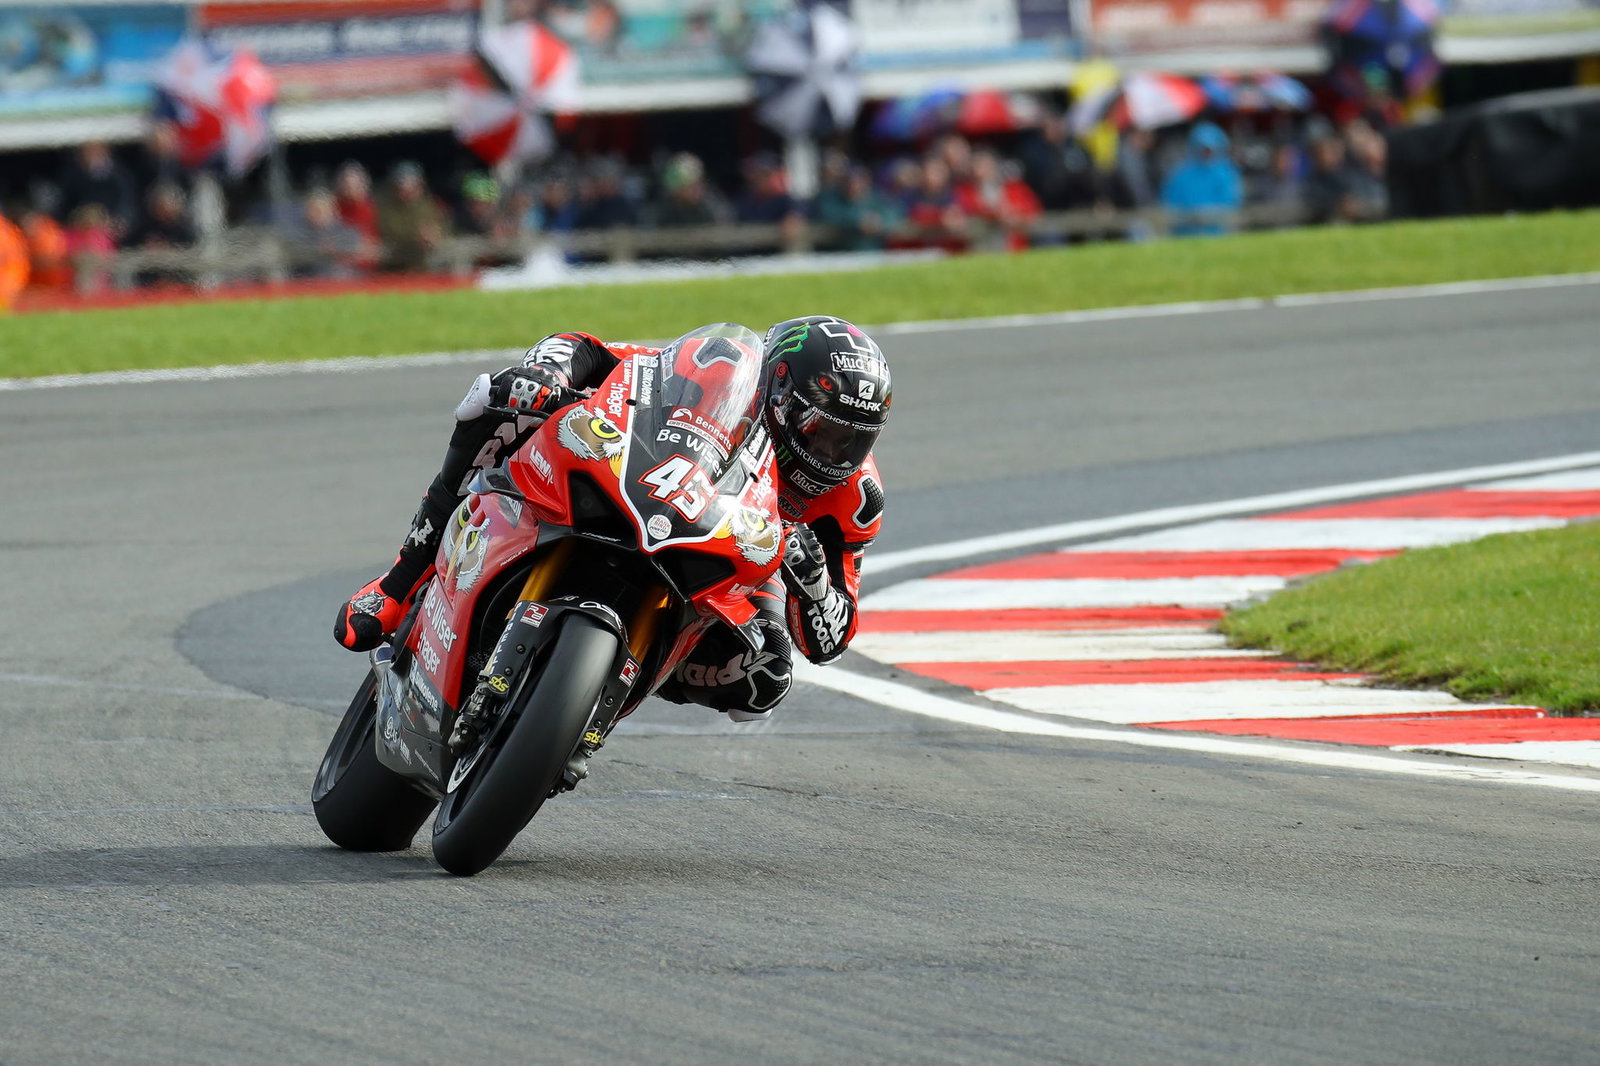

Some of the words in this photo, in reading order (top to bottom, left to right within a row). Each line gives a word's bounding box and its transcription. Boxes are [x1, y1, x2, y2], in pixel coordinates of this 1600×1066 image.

[793, 390, 811, 407] SHARK
[839, 393, 882, 412] SHARK
[695, 416, 732, 451] Bennetts
[656, 429, 682, 443] Be
[686, 435, 723, 477] Wiser
[791, 438, 822, 469] WATCHES
[641, 455, 718, 522] 45
[423, 583, 437, 616] Be
[431, 599, 457, 652] Wiser
[807, 603, 834, 654] TOOLS
[488, 675, 509, 693] sbs
[585, 729, 602, 745] sbs
